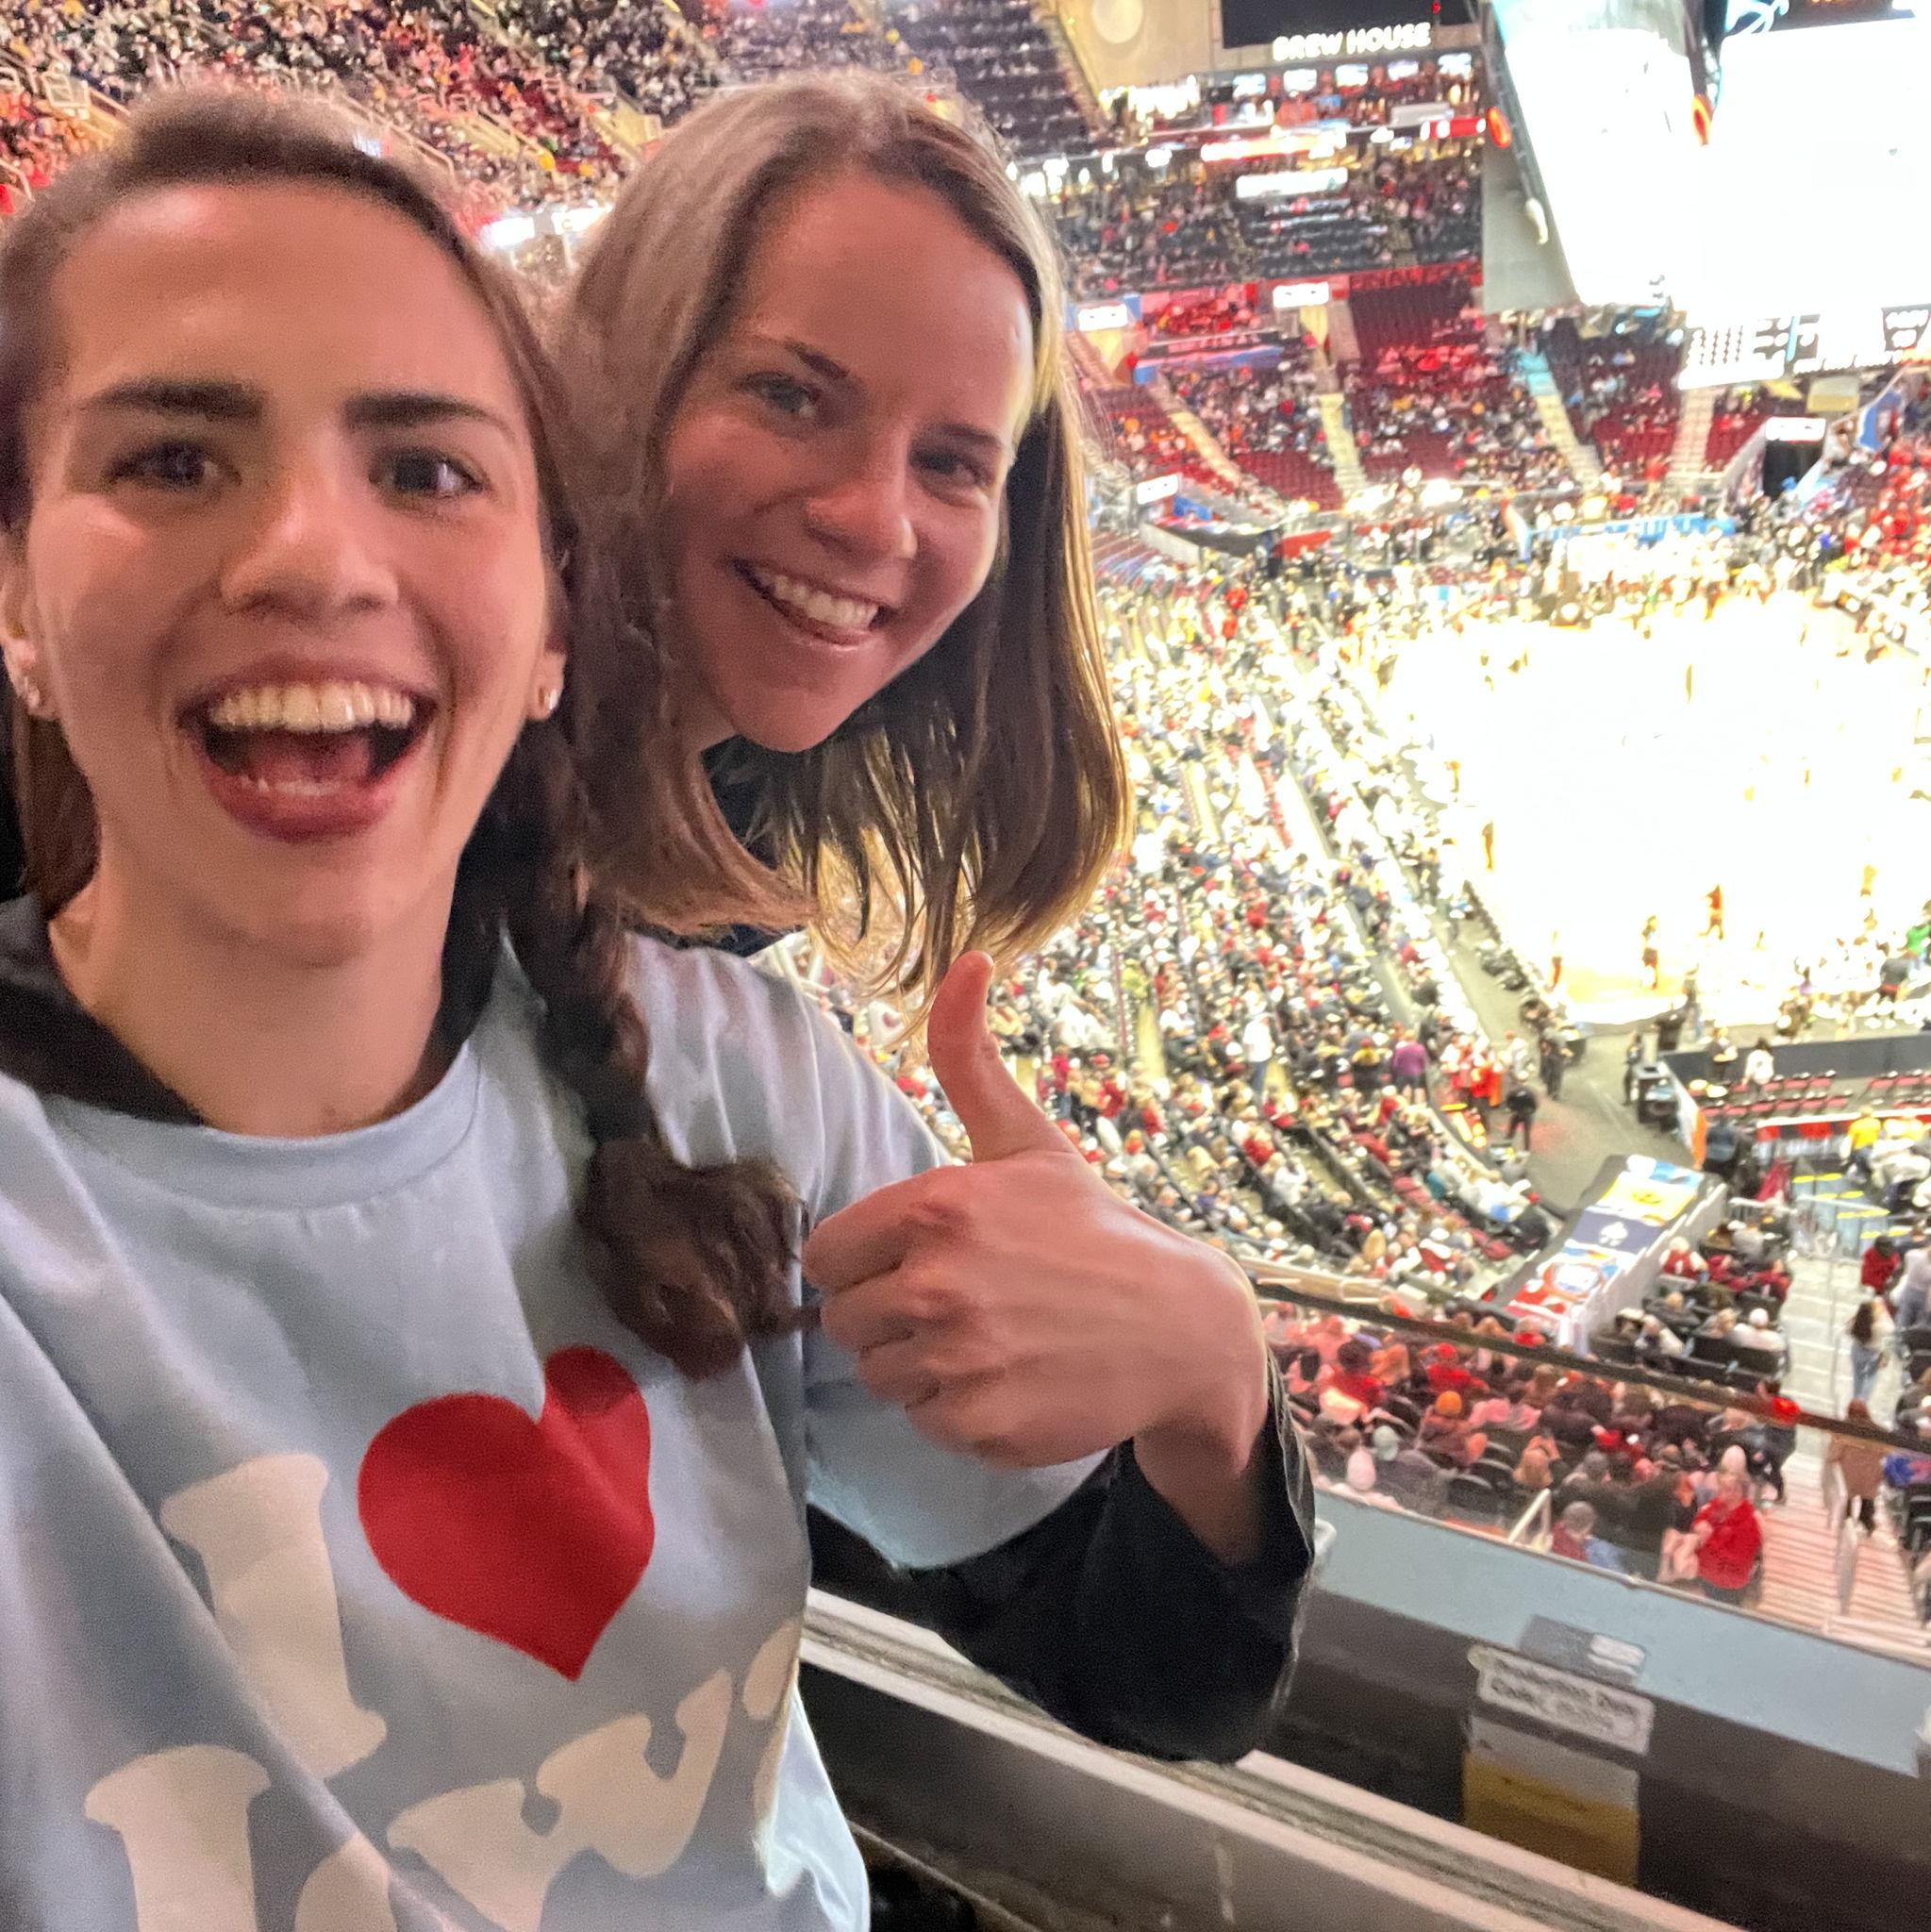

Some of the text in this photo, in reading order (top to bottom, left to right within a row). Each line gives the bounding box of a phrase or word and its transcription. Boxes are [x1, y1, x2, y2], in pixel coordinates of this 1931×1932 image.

[1273, 22, 1432, 61] BREW HOUSE
[159, 1453, 388, 1780] I
